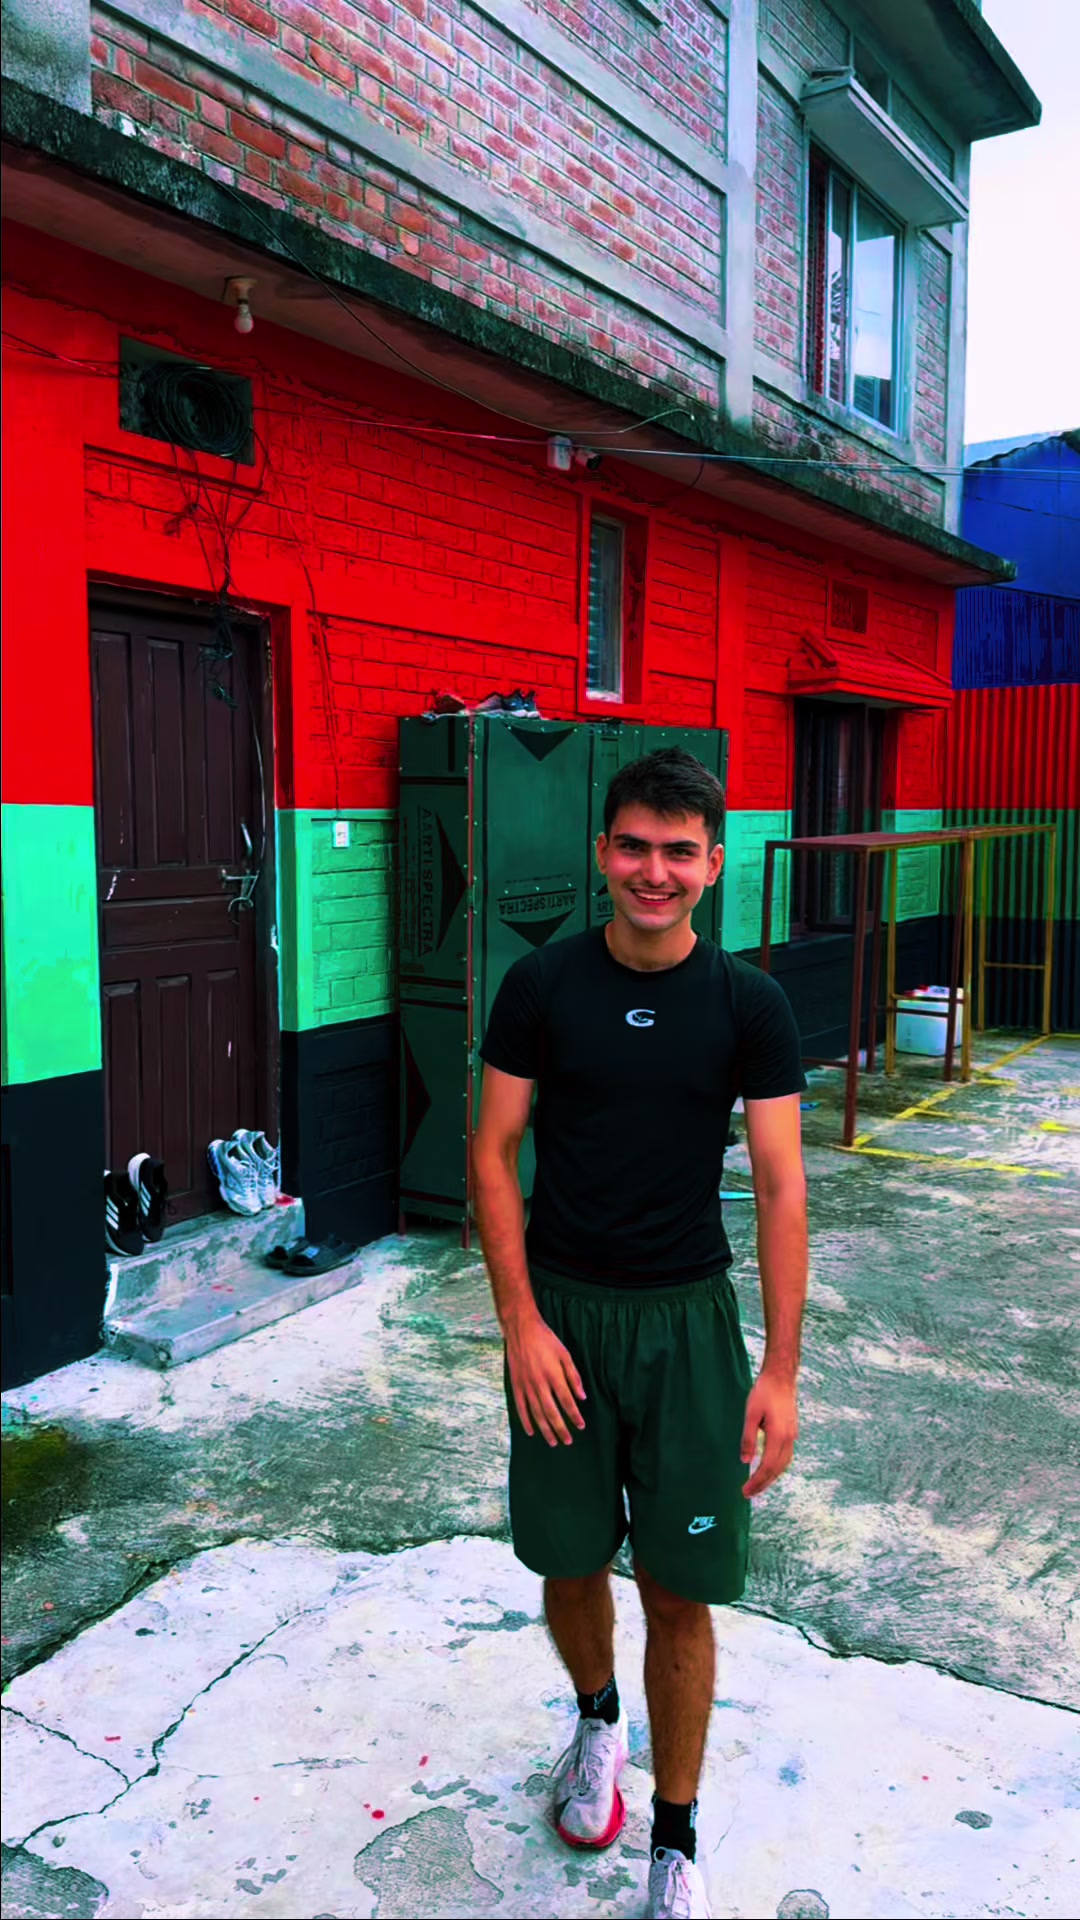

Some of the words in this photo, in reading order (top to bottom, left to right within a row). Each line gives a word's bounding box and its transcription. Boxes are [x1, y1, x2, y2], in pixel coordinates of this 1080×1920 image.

[422, 808, 433, 864] AARTI
[422, 869, 433, 956] SPECTRA
[499, 897, 547, 915] SPECTRA
[547, 893, 577, 909] AARTI
